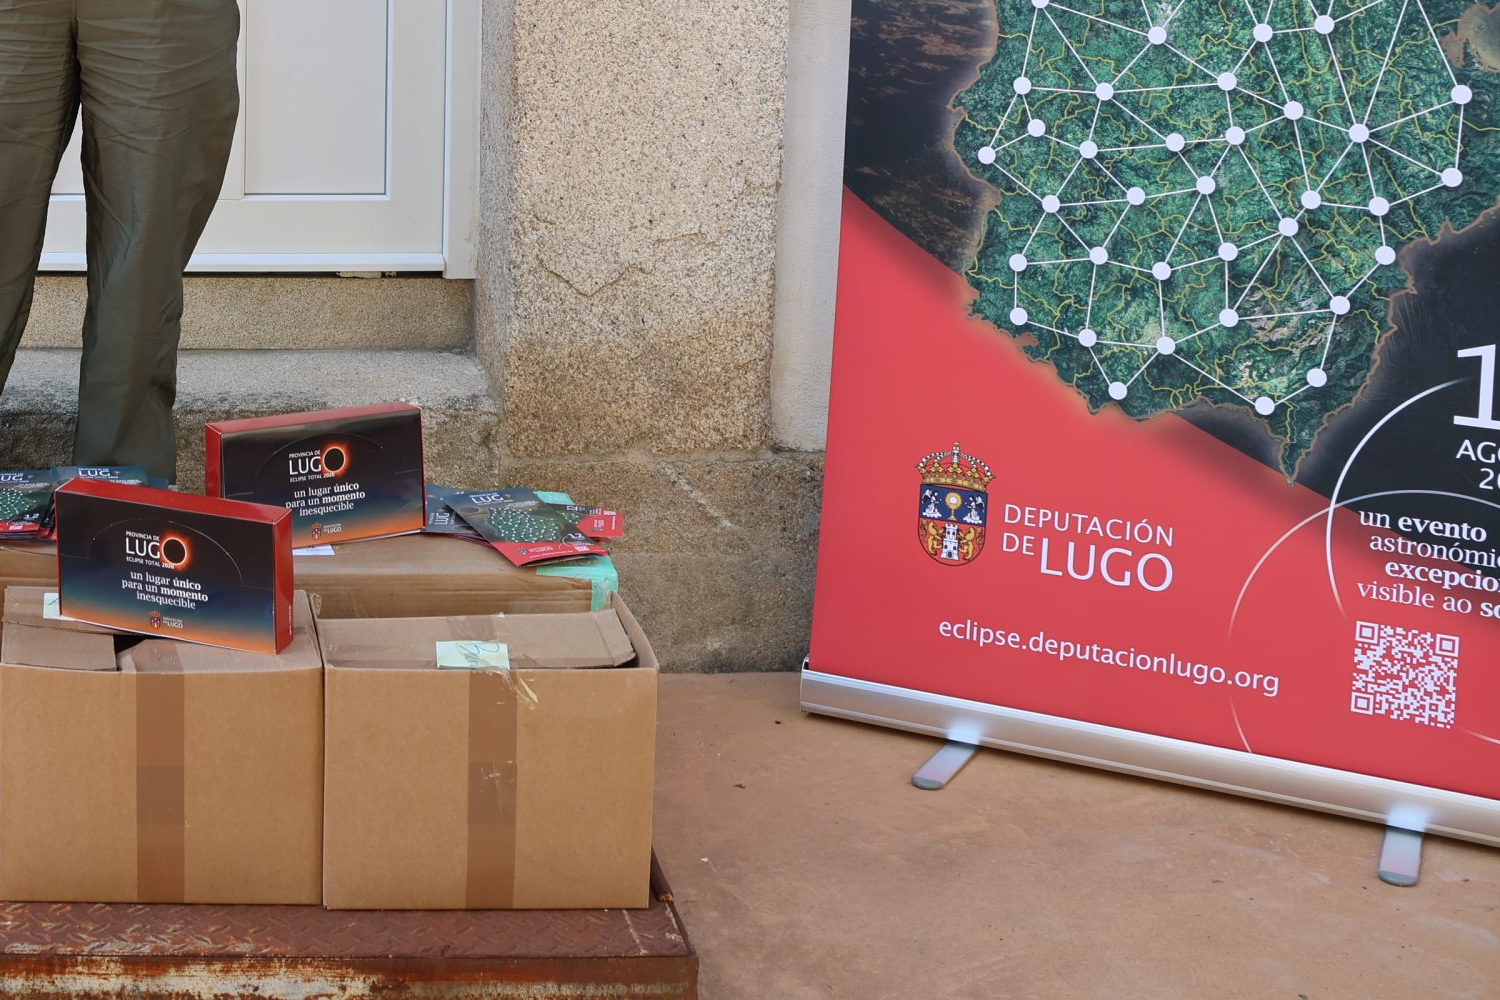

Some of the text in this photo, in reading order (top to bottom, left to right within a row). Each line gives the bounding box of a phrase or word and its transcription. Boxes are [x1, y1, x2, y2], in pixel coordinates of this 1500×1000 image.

[1453, 344, 1500, 430] 1
[289, 446, 346, 475] LUGO
[285, 491, 366, 509] para un momento
[294, 482, 359, 498] un lugar único
[300, 502, 354, 516] inesquecible
[1004, 503, 1174, 547] DEPUTACIÓN
[1359, 510, 1487, 542] un evento
[126, 537, 188, 566] LUGO
[1002, 532, 1174, 592] DE LUGO
[122, 580, 208, 602] para un momento
[131, 571, 201, 590] un lugar único
[1385, 561, 1500, 593] excepcio
[137, 591, 196, 609] inesquecible
[1357, 581, 1435, 608] visible
[1443, 596, 1472, 613] ao
[938, 619, 1281, 698] eclipse.deputacionlugo.org
